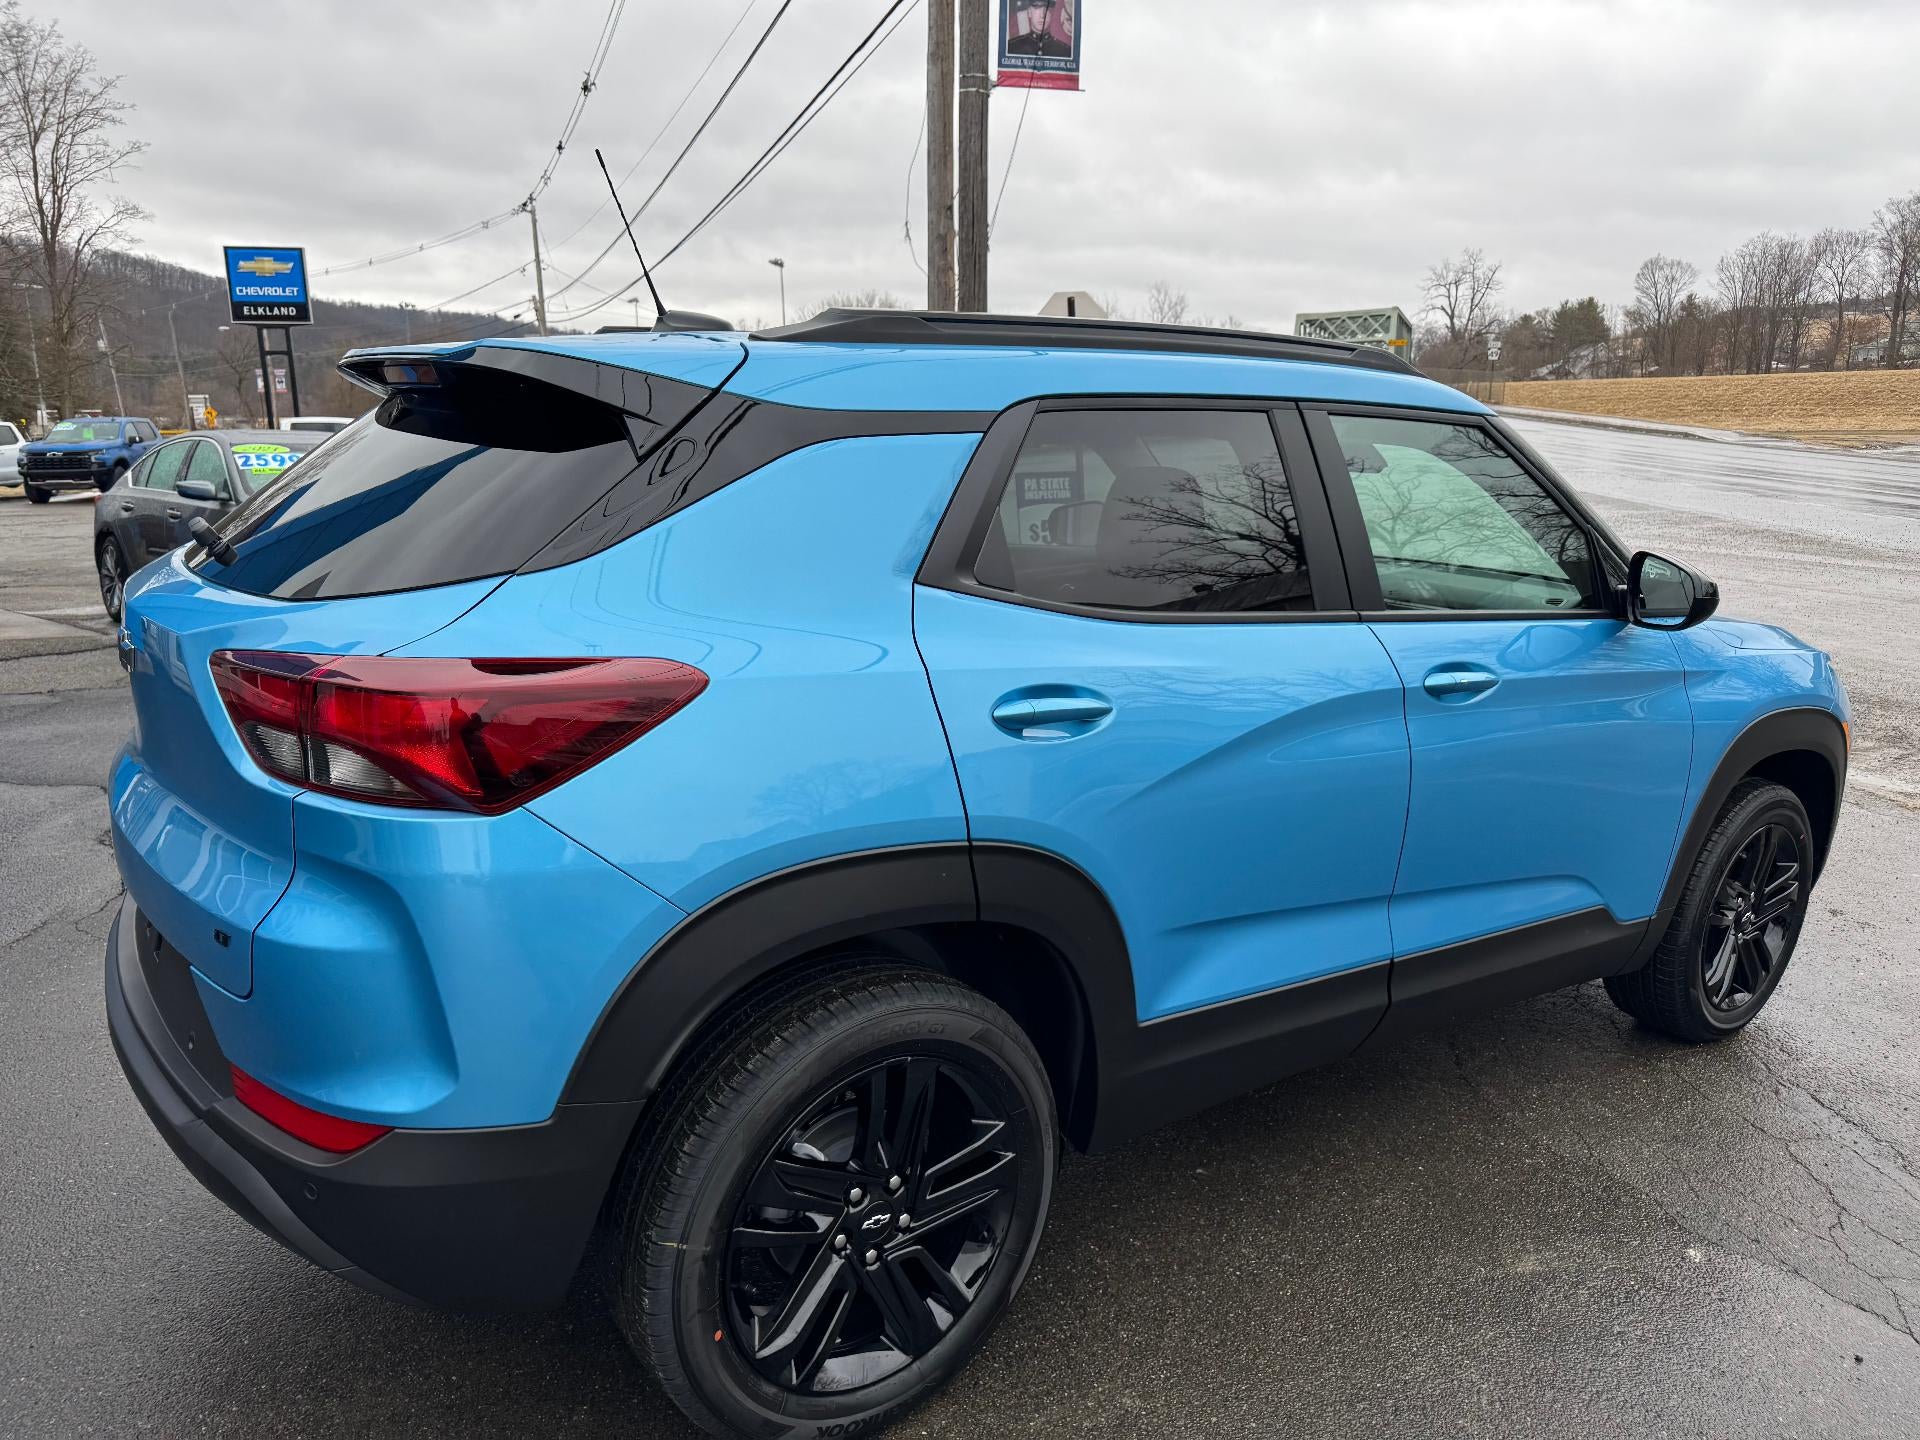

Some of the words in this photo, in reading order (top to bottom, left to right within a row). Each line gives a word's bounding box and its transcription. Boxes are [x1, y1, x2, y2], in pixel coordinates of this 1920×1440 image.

[236, 287, 298, 296] CHEVROLET
[243, 306, 297, 316] ELKLAND
[1024, 479, 1038, 490] PA
[1040, 478, 1070, 490] STATE
[1025, 490, 1071, 500] INSPECTION
